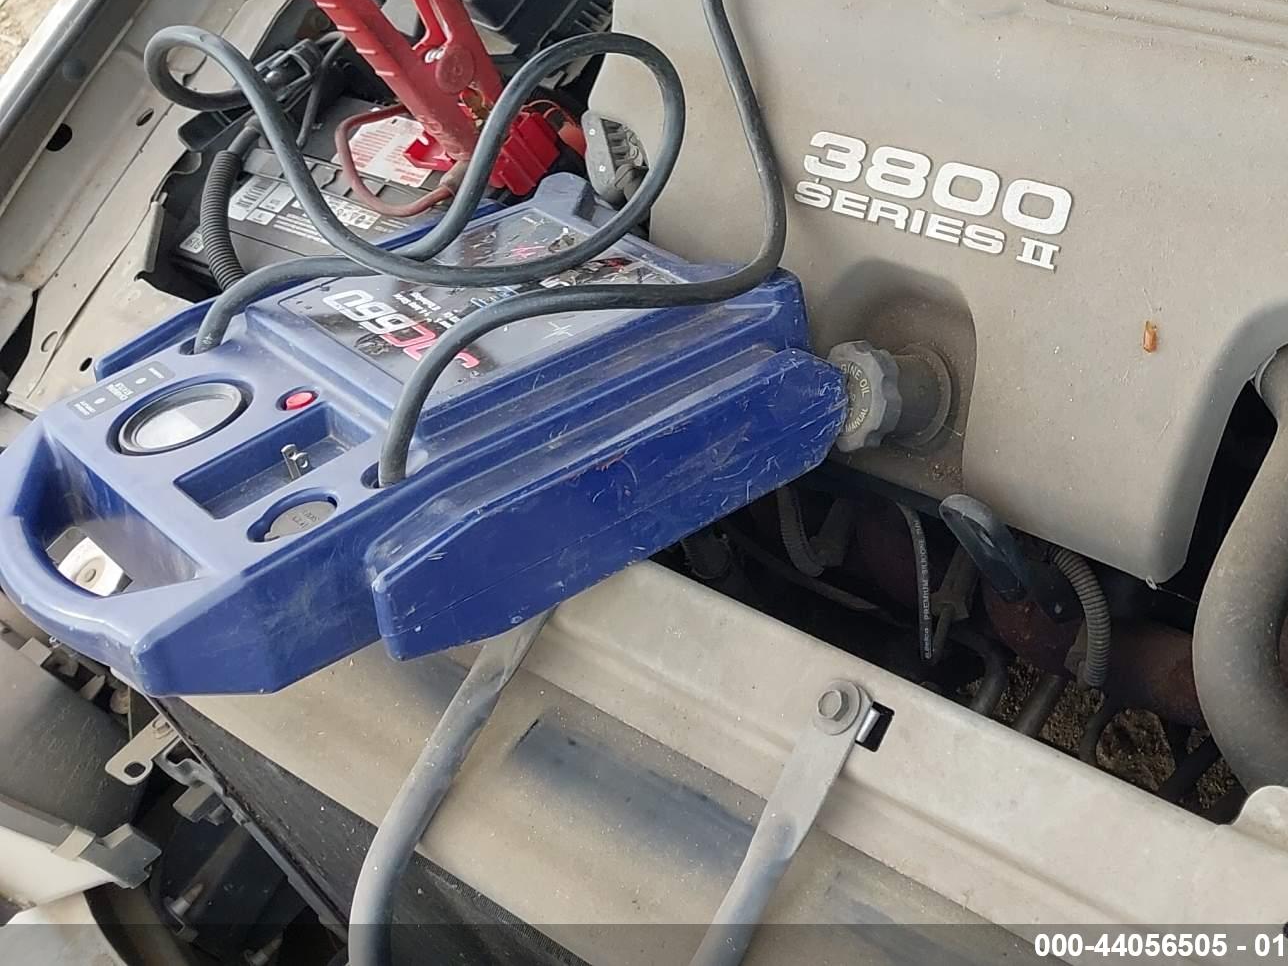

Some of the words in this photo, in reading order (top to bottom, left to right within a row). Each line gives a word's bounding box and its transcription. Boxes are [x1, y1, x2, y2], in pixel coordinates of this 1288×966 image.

[794, 179, 1007, 255] SERIES
[1016, 236, 1061, 272] II
[804, 130, 1073, 235] 3800
[859, 378, 871, 399] OIL
